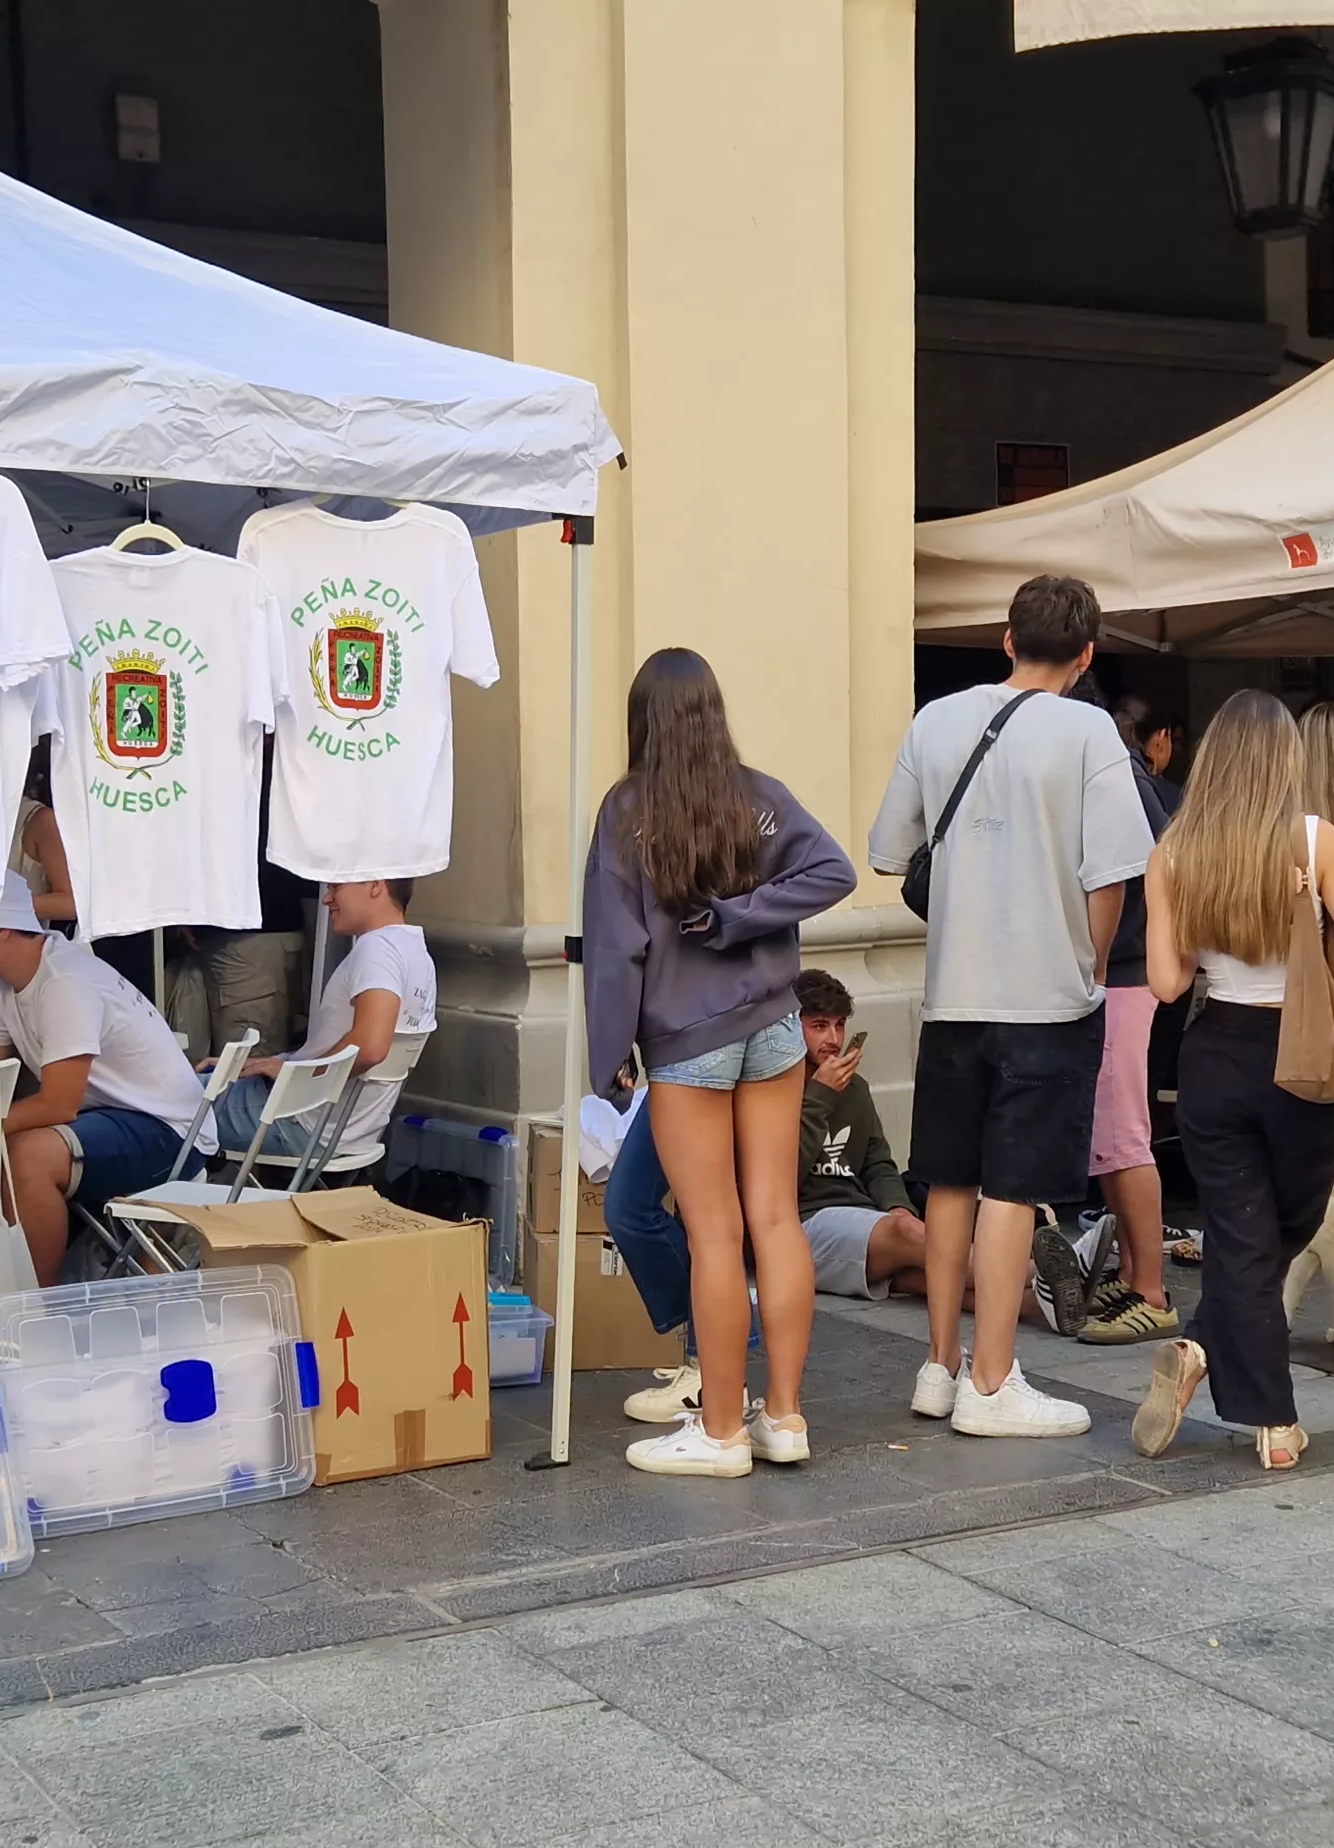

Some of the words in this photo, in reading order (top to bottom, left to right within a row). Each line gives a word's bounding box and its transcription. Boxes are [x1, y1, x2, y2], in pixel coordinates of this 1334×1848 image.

[290, 577, 357, 627] PEÑA
[363, 579, 425, 632] ZOITI
[68, 618, 135, 672] PEÑA
[144, 619, 209, 675] ZOITI
[111, 674, 163, 684] RECREATIVA
[307, 725, 401, 761] HUESCA
[89, 776, 187, 812] HUESCA
